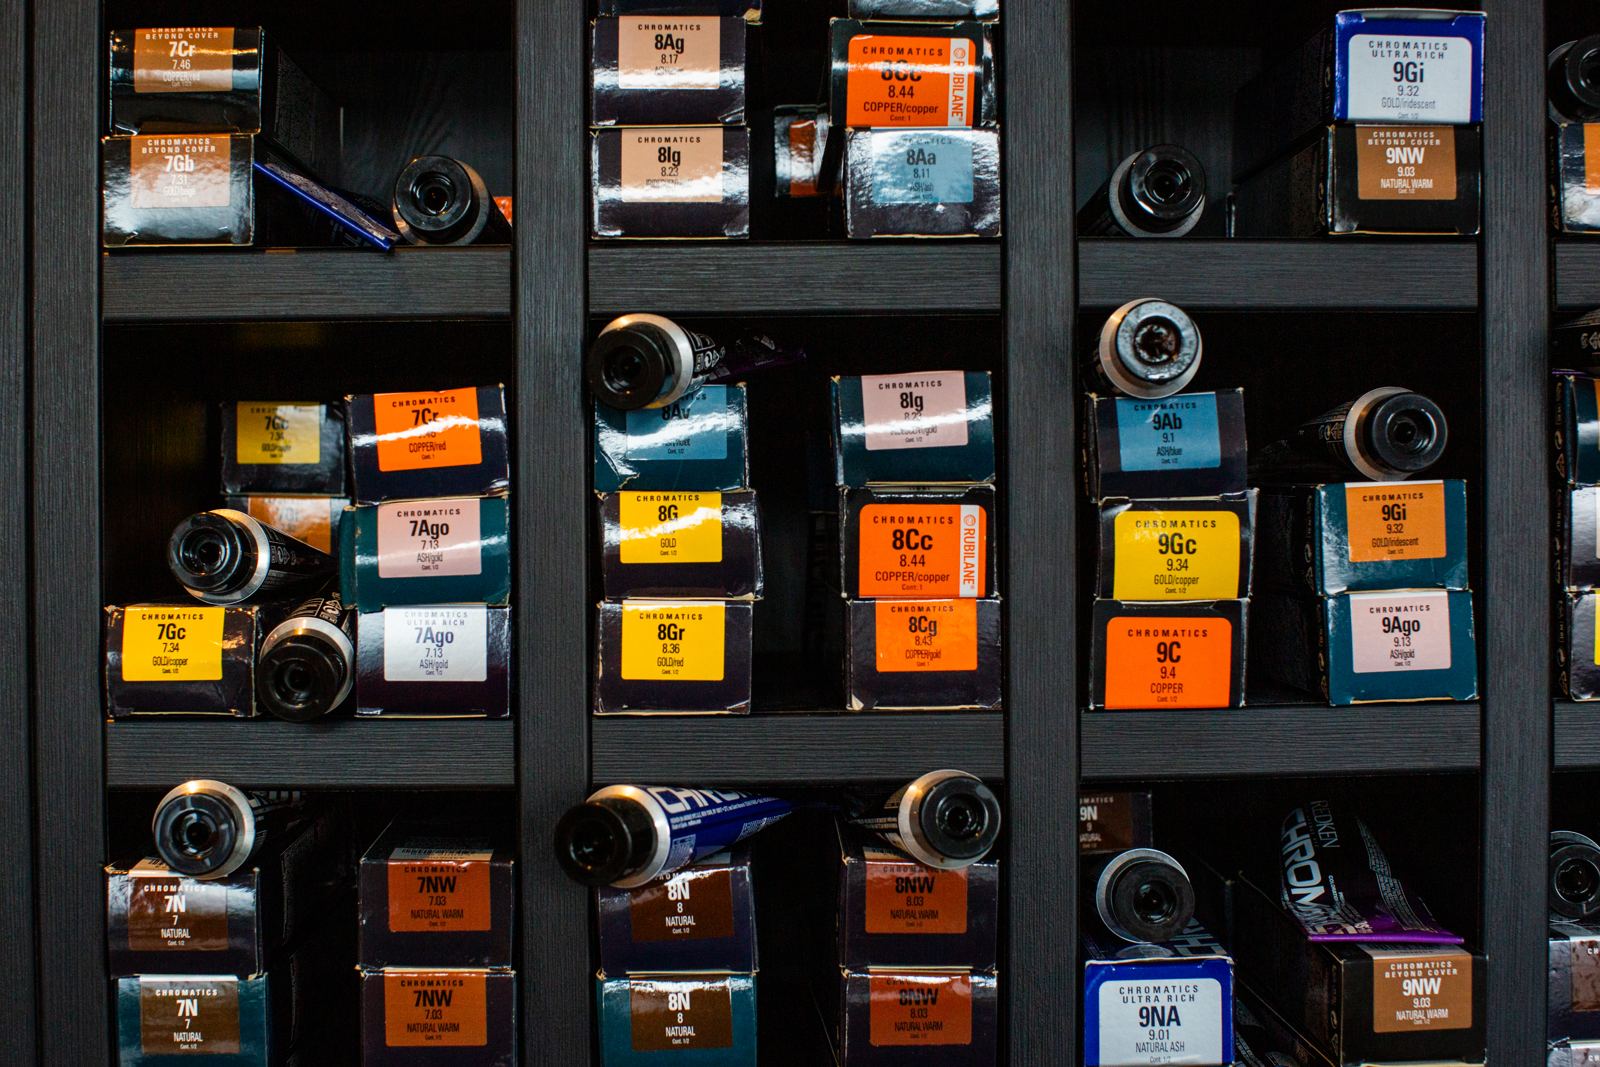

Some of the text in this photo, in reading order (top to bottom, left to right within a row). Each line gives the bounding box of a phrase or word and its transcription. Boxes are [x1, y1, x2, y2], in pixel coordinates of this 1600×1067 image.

[170, 41, 196, 57] 7Cr
[655, 34, 684, 53] 8Ag
[1369, 41, 1448, 50] CHROMATICS
[863, 47, 943, 56] CHROMATICS
[172, 60, 190, 69] 7.46
[661, 55, 678, 64] 8.17
[1393, 61, 1424, 83] 9Gi
[888, 86, 914, 98] 8.44
[1397, 85, 1420, 97] 9.32
[863, 102, 938, 115] COPPER/copper
[1381, 97, 1435, 109] GOLD/iridescent
[148, 138, 210, 146] CHROMATICS
[658, 147, 680, 167] 8Ig
[907, 148, 936, 165] 8Aa
[1386, 147, 1425, 165] 9NW
[164, 155, 194, 172] 7Gb
[661, 167, 679, 176] 8.23
[914, 168, 929, 178] 8.11
[1398, 167, 1414, 177] 9.03
[1381, 178, 1433, 189] NATURAL WARM
[879, 381, 942, 389] CHROMATICS
[392, 396, 455, 407] CHROMATICS
[900, 392, 924, 411] 8Ig
[1134, 402, 1196, 411] CHROMATICS
[412, 408, 439, 425] 7Cr
[1153, 414, 1182, 431] 9Ab
[1163, 433, 1174, 442] 9.1
[409, 442, 446, 452] COPPER/red
[1363, 493, 1423, 502] CHROMATICS
[397, 509, 460, 517] CHROMATICS
[658, 505, 678, 522] 8G
[1382, 504, 1406, 521] 9Gi
[873, 516, 953, 524] CHROMATICS
[1136, 520, 1217, 528] CHROMATICS
[409, 520, 450, 538] 7Ago
[1386, 524, 1404, 534] 9.32
[421, 540, 439, 550] 7.13
[661, 539, 676, 548] GOLD
[892, 529, 933, 550] 8Cc
[1158, 533, 1197, 555] 9Gc
[417, 553, 443, 564] ASH/gold
[900, 554, 926, 567] 8.44
[963, 528, 975, 585] RUBILANE
[1167, 559, 1188, 571] 9.34
[875, 571, 950, 584] COPPER/copper
[1154, 575, 1199, 587] GOLD/copper
[1370, 605, 1430, 613] CHROMATICS
[908, 616, 938, 636] 8Cg
[1382, 617, 1420, 636] 9Ago
[157, 624, 186, 640] 7Gc
[414, 627, 454, 647] 7Ago
[658, 624, 685, 640] 8Gr
[1128, 629, 1208, 637] CHROMATICS
[915, 636, 932, 646] 8.43
[1394, 637, 1411, 647] 9.13
[162, 643, 179, 652] 7.34
[426, 648, 443, 658] 7.13
[662, 644, 680, 653] 8.36
[1156, 641, 1181, 663] 9C
[905, 650, 941, 660] COPPER/gold
[1390, 650, 1415, 661] ASH/gold
[152, 656, 188, 666] GOLD/copper
[419, 659, 448, 670] ASH/gold
[657, 657, 684, 667] GOLD/red
[1160, 666, 1176, 679] 9.4
[1150, 683, 1183, 694] COPPER
[1080, 806, 1098, 820] 9N
[1310, 800, 1340, 848] REDKEN
[417, 876, 456, 893] 7NW
[895, 877, 935, 894] 8NW
[668, 881, 690, 900] 8N
[164, 895, 186, 912] 7N
[429, 896, 446, 906] 7.03
[906, 896, 923, 906] 8.03
[677, 902, 683, 913] 8
[411, 909, 464, 919] NATURAL WARM
[890, 909, 938, 920] NATURAL WARM
[173, 915, 178, 925] 7
[665, 916, 696, 926] NATURAL
[161, 928, 190, 938] NATURAL
[1390, 962, 1452, 970] CHROMATICS
[1385, 970, 1424, 978] BEYOND
[1119, 985, 1199, 994] CHROMATICS
[1402, 978, 1441, 996] 9NW
[414, 990, 453, 1007] 7NW
[668, 992, 690, 1011] 8N
[899, 988, 938, 1006] 8NW
[1123, 994, 1196, 1004] ULTRA RICH
[176, 999, 198, 1017] 7N
[1414, 998, 1430, 1008] 9.03
[425, 1010, 442, 1020] 7.03
[678, 1013, 683, 1023] 8
[910, 1009, 928, 1018] 8.03
[1138, 1005, 1181, 1027] 9NA
[1396, 1008, 1448, 1020] NATURAL WARM
[185, 1019, 190, 1029] 7
[407, 1023, 459, 1033] NATURAL WARM
[894, 1022, 943, 1032] NATURAL WARM
[174, 1032, 203, 1042] NATURAL
[666, 1027, 695, 1037] NATURAL
[1149, 1029, 1170, 1041] 9.01
[1136, 1042, 1185, 1053] NATURAL ASH
